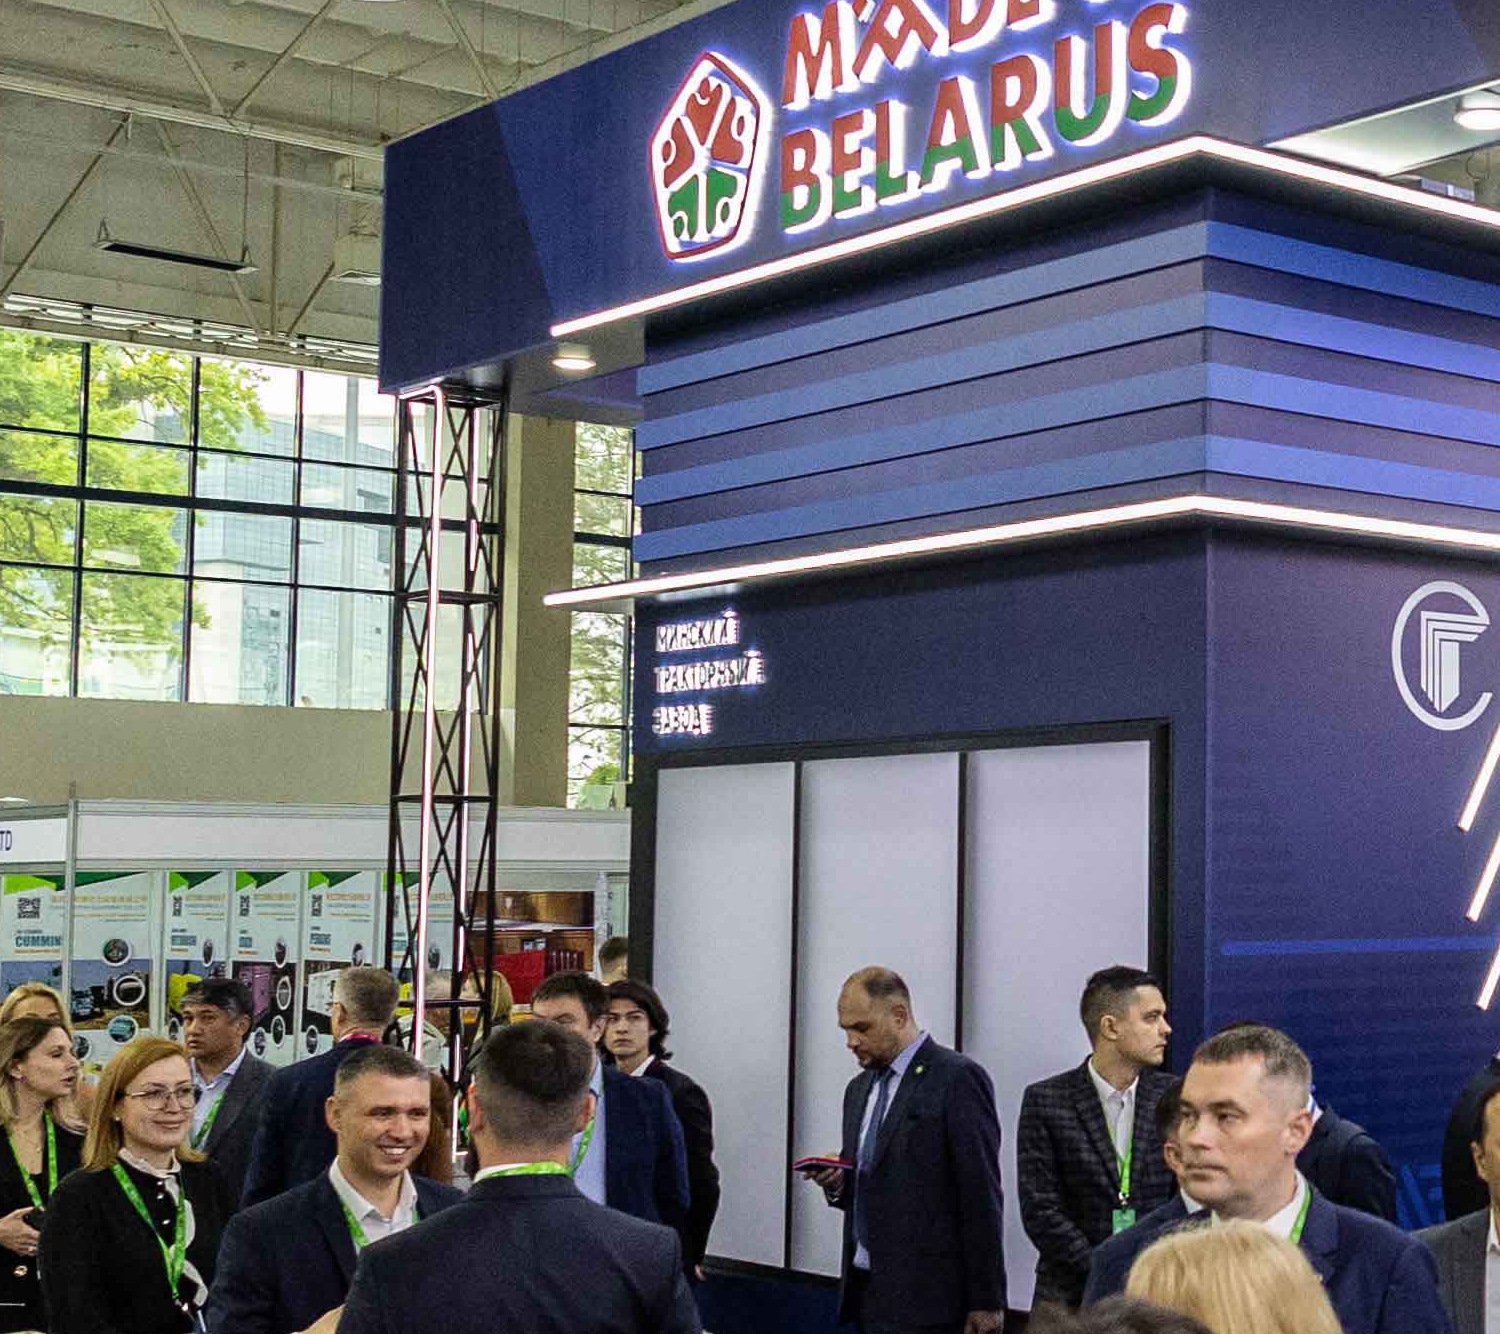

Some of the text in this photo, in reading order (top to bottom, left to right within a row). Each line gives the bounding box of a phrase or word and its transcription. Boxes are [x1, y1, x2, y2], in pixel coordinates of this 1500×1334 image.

[780, 3, 1190, 233] BELARUS
[656, 607, 740, 652] МИНСКИЙ
[653, 650, 766, 693] ТРАКТОРНЫЙ
[652, 704, 714, 735] ЗАВОД
[15, 934, 62, 948] CUMMIN
